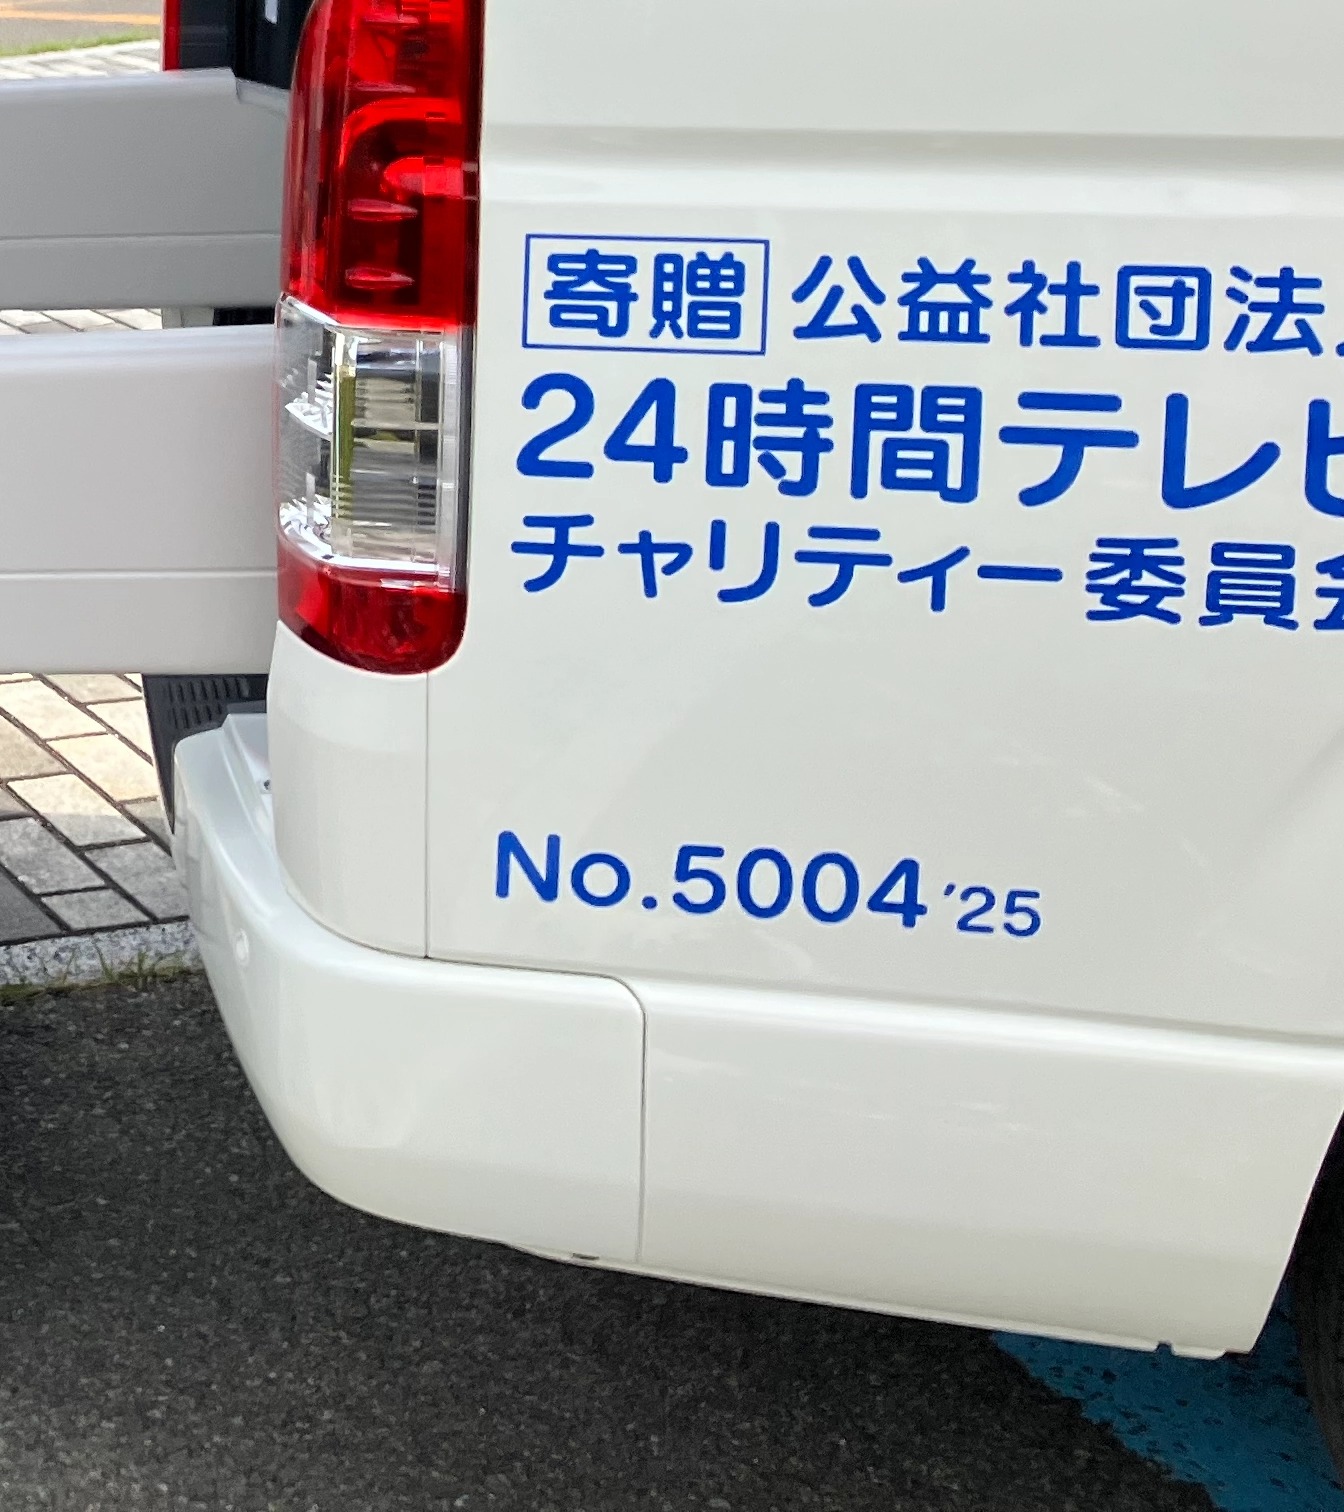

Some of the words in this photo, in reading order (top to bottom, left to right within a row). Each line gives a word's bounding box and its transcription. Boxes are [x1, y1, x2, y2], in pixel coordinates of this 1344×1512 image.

[544, 248, 746, 341] 寄贈
[792, 255, 1344, 357] 公益社団法
[496, 831, 928, 929] No.5004
